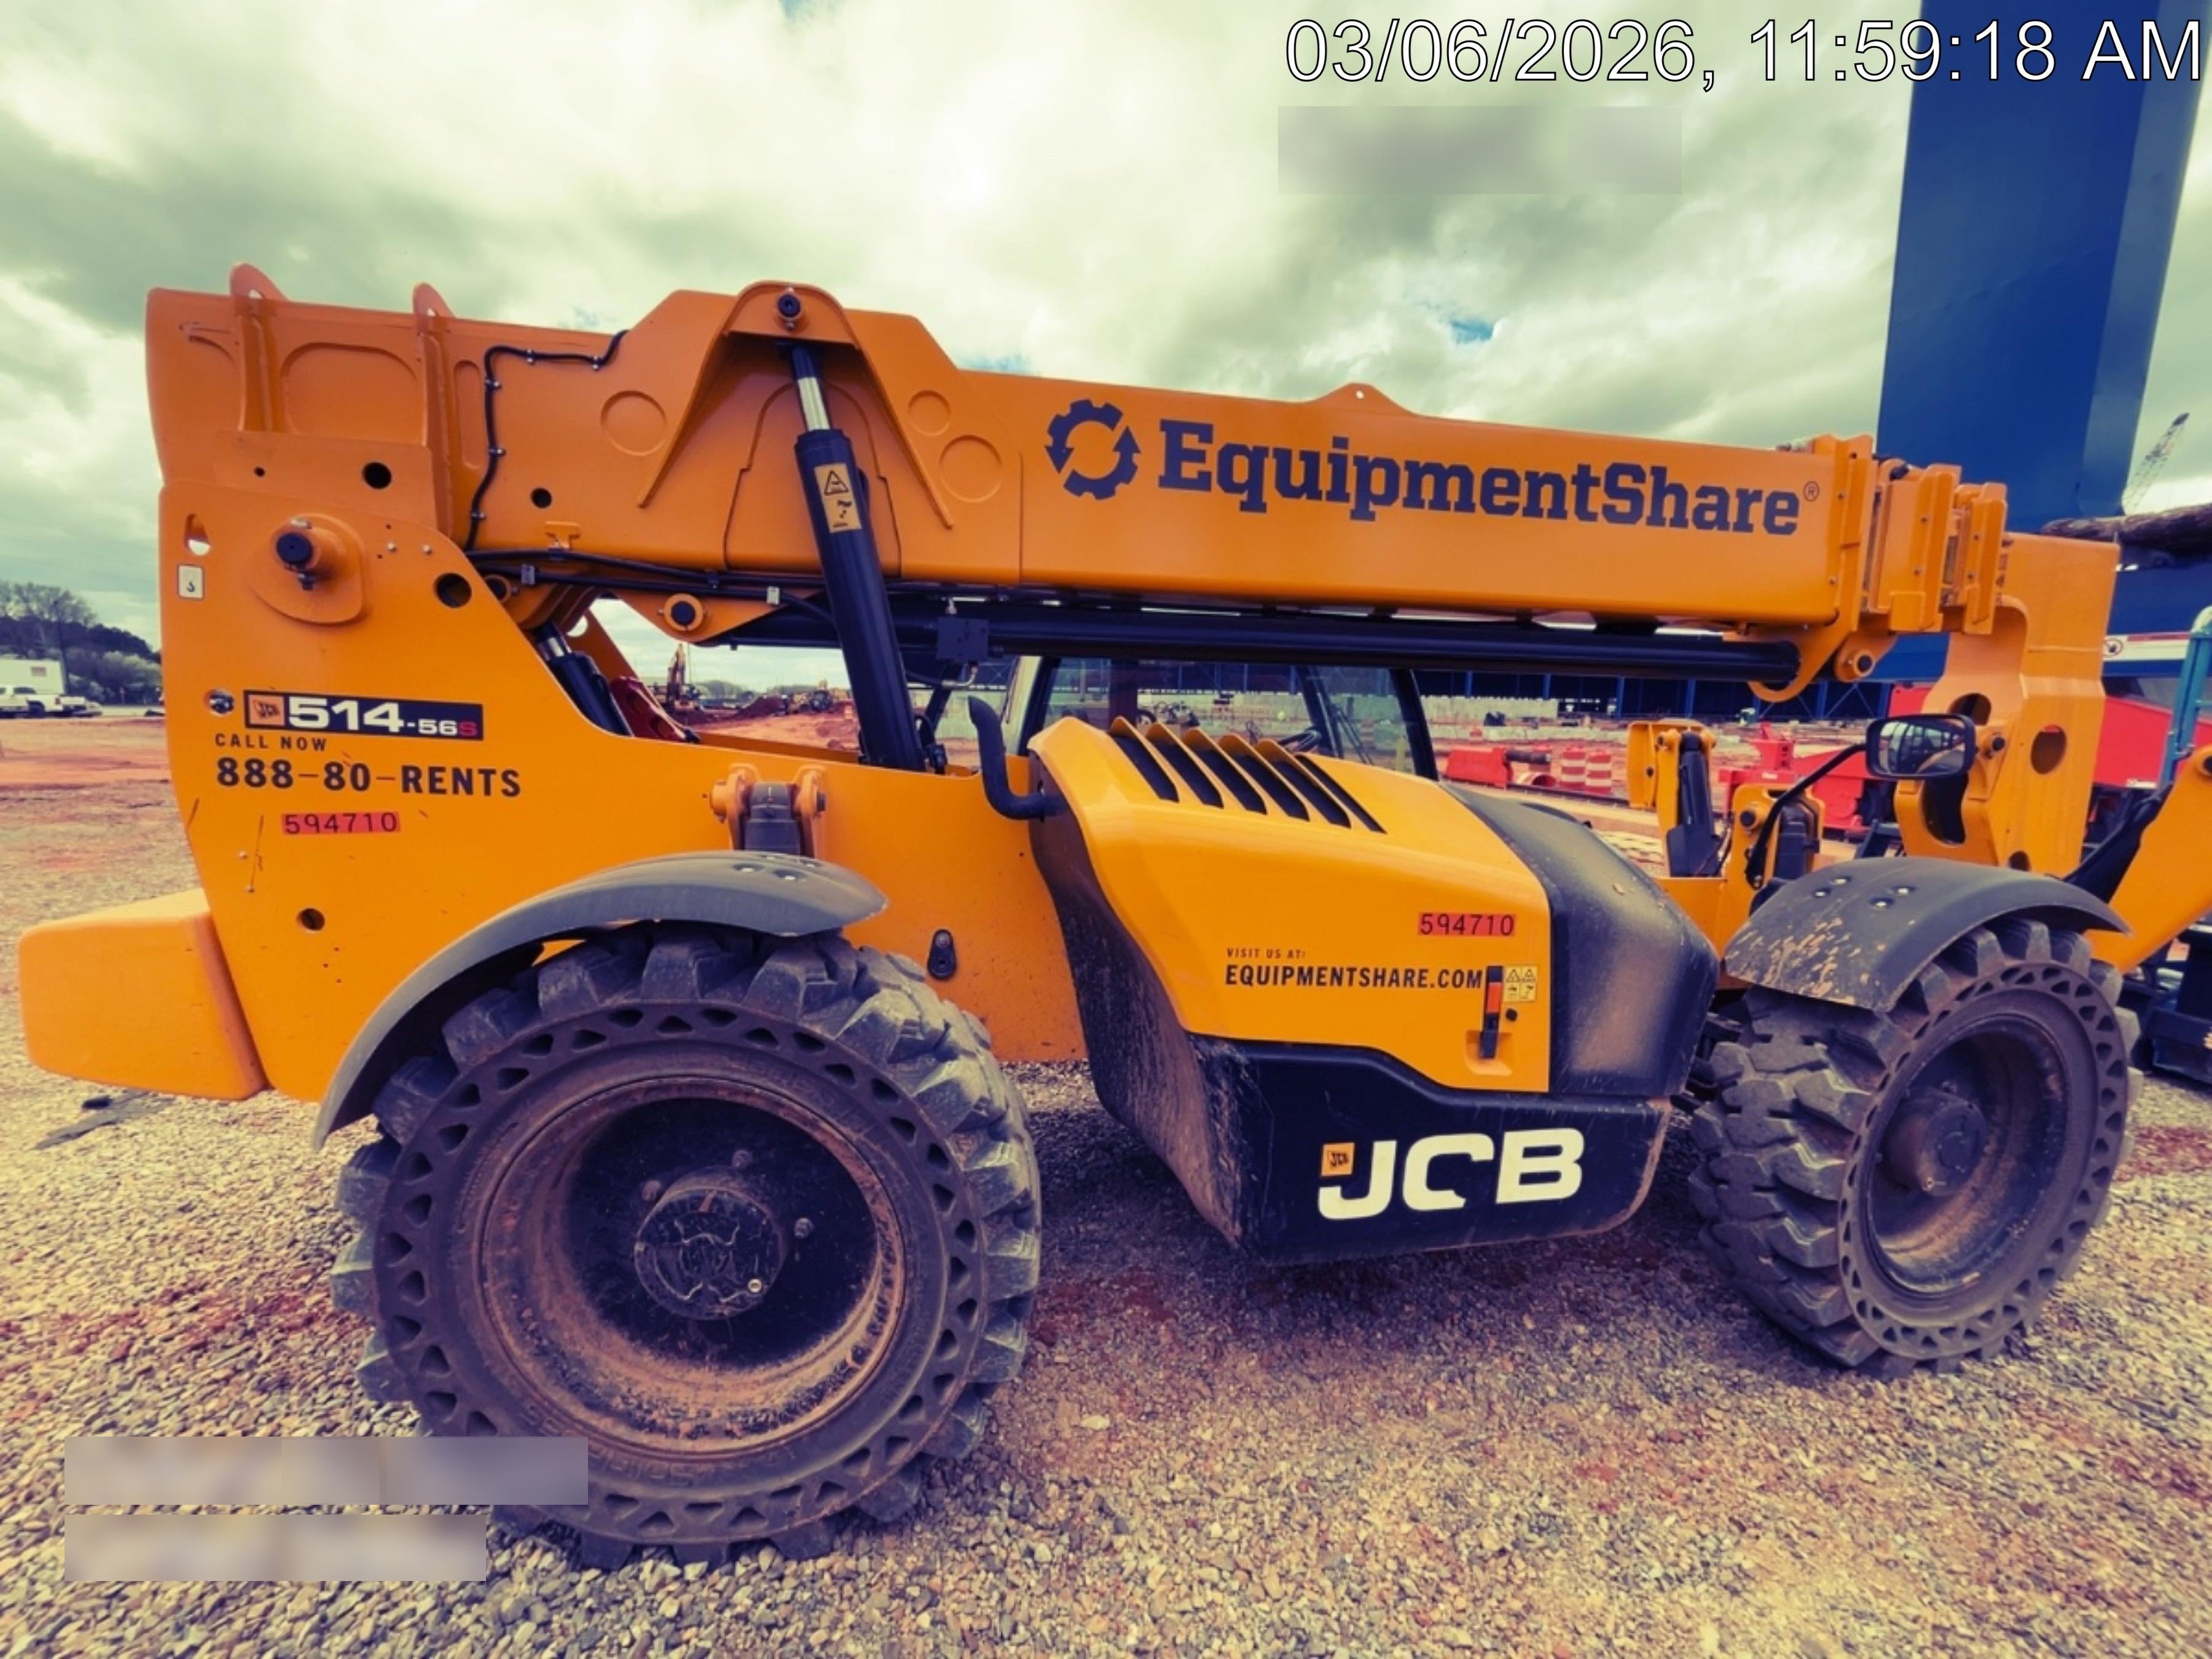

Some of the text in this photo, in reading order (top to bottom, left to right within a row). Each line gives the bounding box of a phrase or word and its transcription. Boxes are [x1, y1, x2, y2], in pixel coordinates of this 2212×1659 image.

[214, 732, 327, 751] CALL NOW
[216, 756, 522, 798] 888-80-RENTS
[284, 812, 398, 834] 594710
[1419, 913, 1515, 936] 594710
[1226, 947, 1260, 959] VISIT
[1266, 948, 1282, 959] US
[1225, 964, 1483, 989] EQUIPMENTSHARE.COM
[1317, 1128, 1585, 1220] JCB
